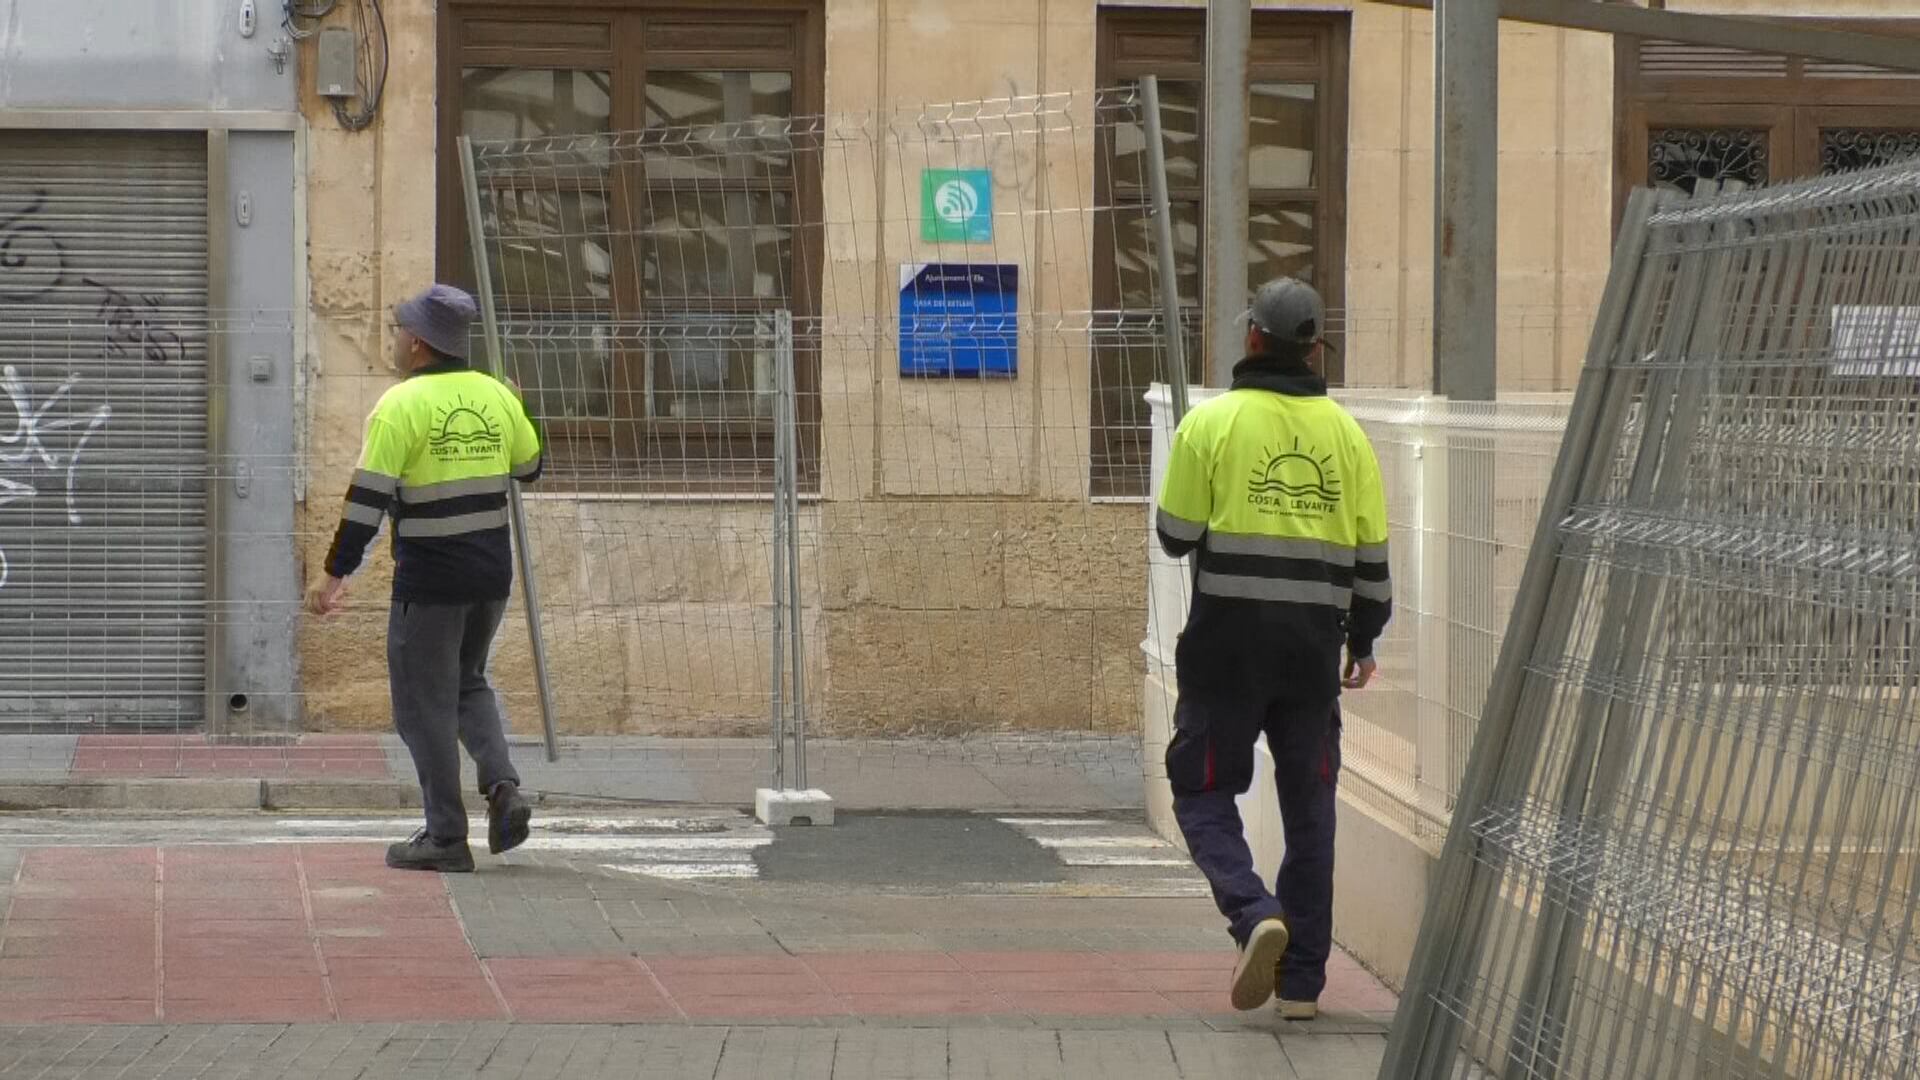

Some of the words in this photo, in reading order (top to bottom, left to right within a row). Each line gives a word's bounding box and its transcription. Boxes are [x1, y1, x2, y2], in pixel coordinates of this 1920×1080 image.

[925, 274, 965, 283] Ajuntament
[430, 446, 459, 455] COSTA
[465, 444, 502, 454] LEVANTE
[1247, 494, 1281, 507] COSTA
[1290, 500, 1336, 513] LEVANTE
